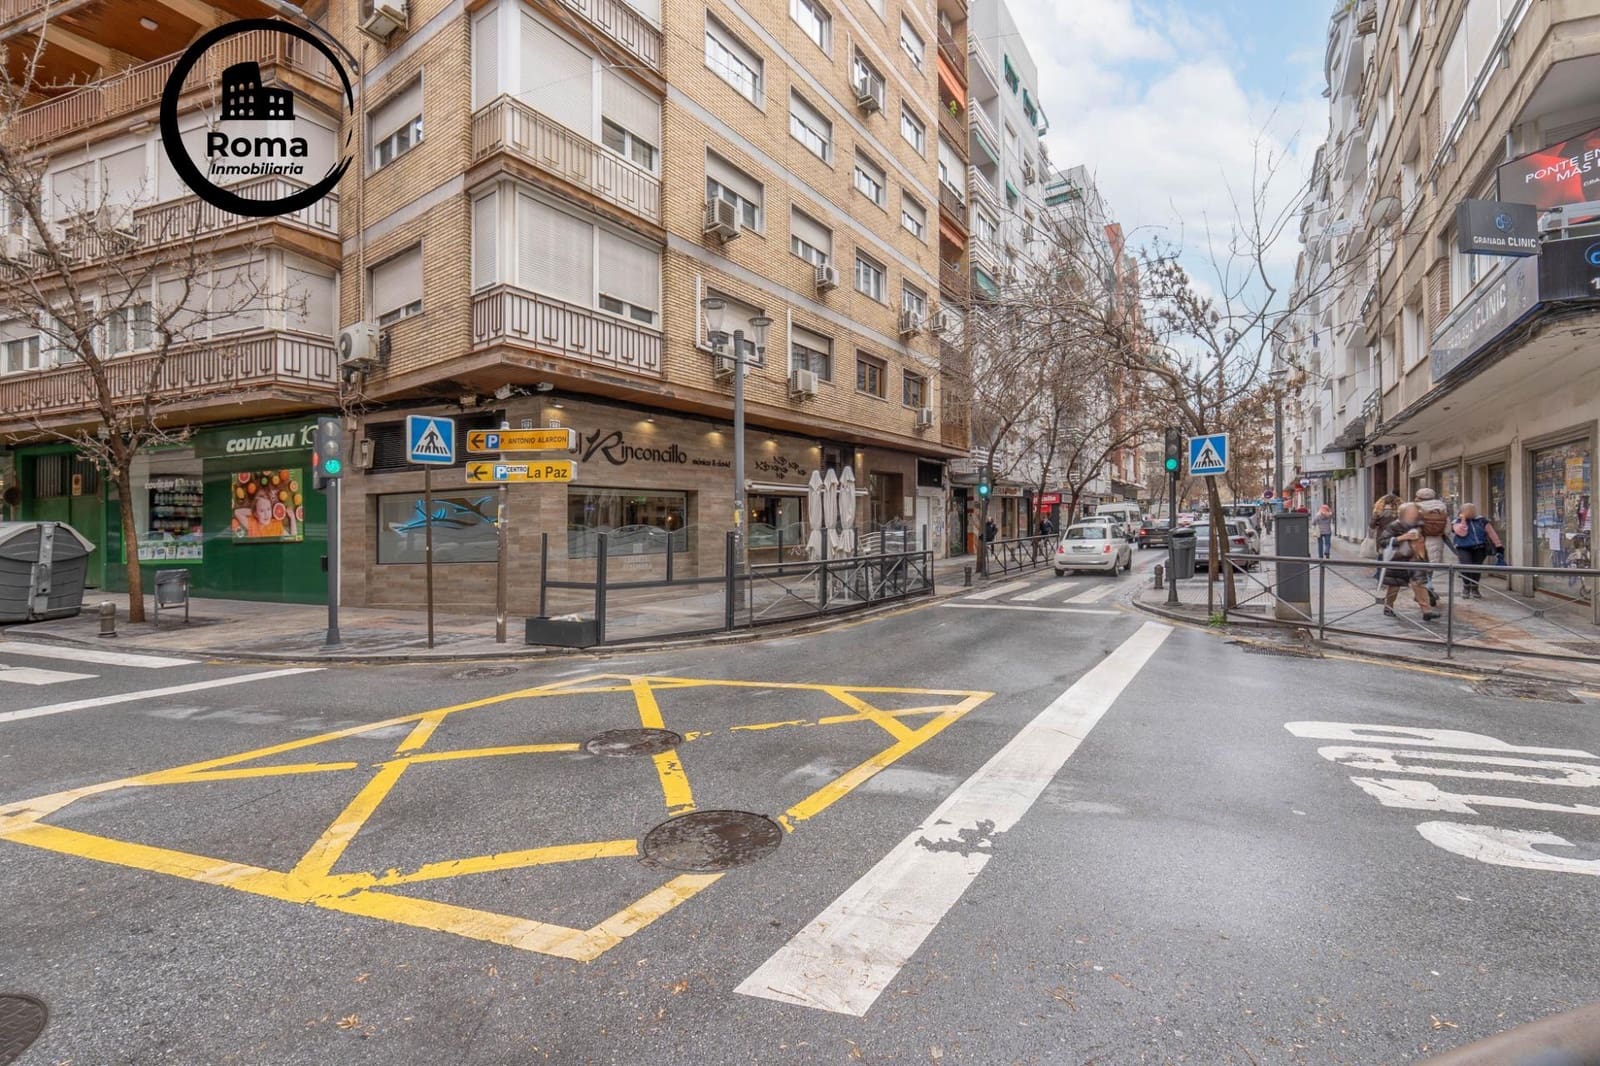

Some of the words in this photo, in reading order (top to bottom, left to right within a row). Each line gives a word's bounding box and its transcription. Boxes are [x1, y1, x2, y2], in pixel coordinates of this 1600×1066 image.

[1525, 155, 1579, 184] PONTE
[1473, 236, 1505, 246] GRANADA
[1508, 237, 1536, 248] CLINIC
[1474, 283, 1507, 330] CLINIC
[582, 429, 688, 465] Rinconcillo
[527, 467, 541, 479] La
[545, 466, 568, 479] Paz
